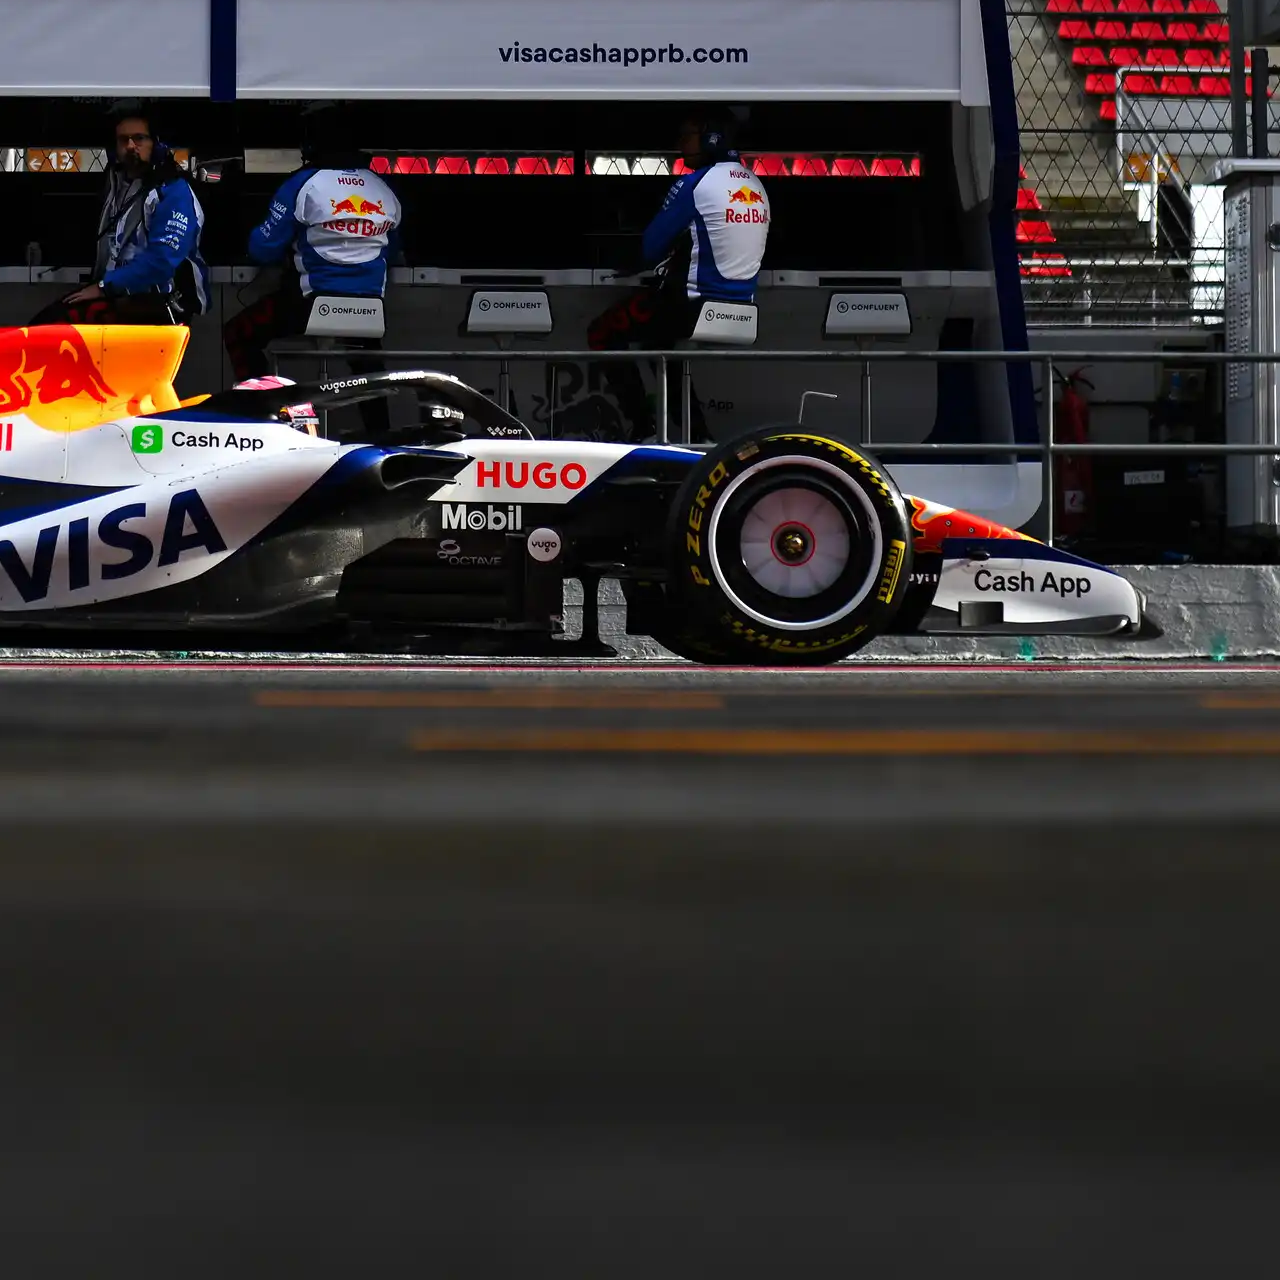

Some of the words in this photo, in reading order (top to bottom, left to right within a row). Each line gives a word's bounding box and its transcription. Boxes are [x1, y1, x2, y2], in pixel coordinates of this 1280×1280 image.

[498, 40, 750, 67] visacashapprb.com
[48, 151, 74, 171] 13
[337, 177, 365, 187] HUGO
[729, 170, 750, 180] HUGO
[172, 210, 188, 225] VISA
[726, 208, 751, 223] Red
[331, 306, 377, 316] CONFLUENT
[492, 300, 542, 311] CONFLUENT
[850, 302, 900, 312] CONFLUENT
[715, 312, 753, 323] CONFLUENT
[320, 376, 368, 394] yugo.com
[171, 430, 220, 450] Cash
[223, 431, 265, 453] App
[477, 461, 587, 490] HUGO
[686, 461, 728, 557] ZERO
[441, 504, 523, 531] Mobil
[531, 540, 558, 553] yugo
[448, 556, 503, 566] OCTAVE
[689, 563, 711, 588] P
[877, 538, 907, 605] PIRELLI
[974, 569, 1034, 593] Cash
[1040, 571, 1092, 599] App
